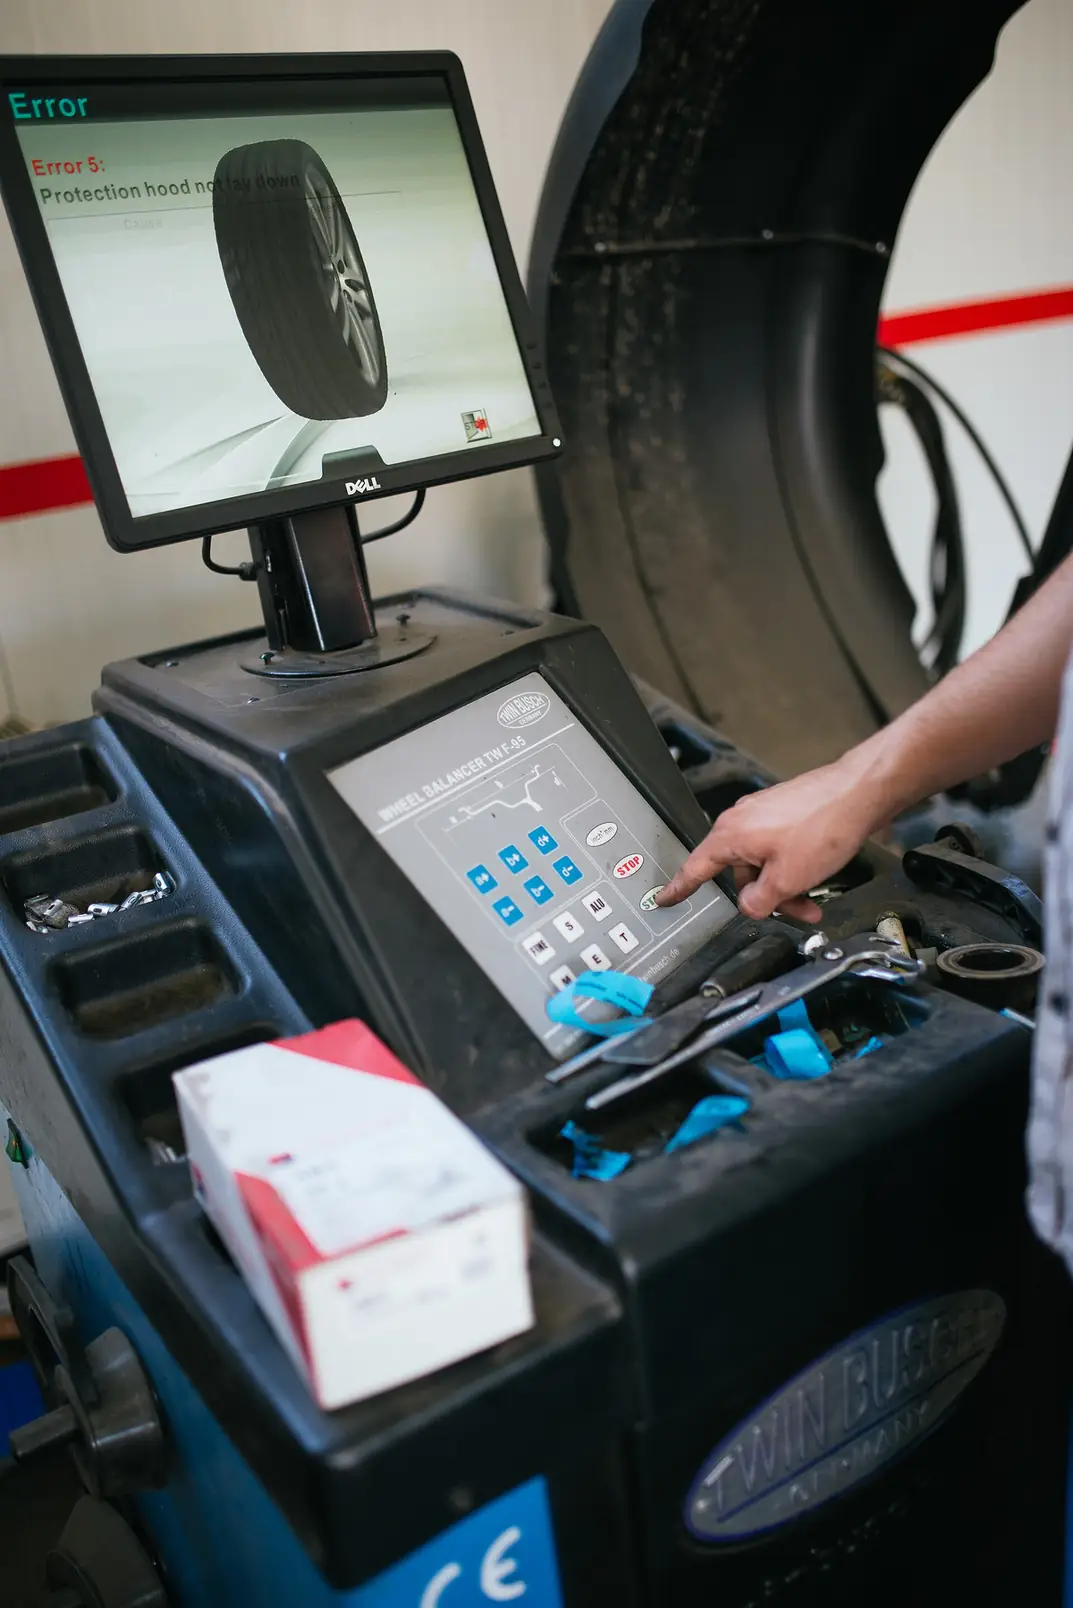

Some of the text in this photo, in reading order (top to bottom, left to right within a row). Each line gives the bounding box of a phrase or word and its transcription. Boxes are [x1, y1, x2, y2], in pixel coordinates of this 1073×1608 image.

[8, 93, 88, 119] Error
[31, 156, 106, 176] Error 5:
[40, 174, 300, 205] Protection hood not lay down
[345, 477, 381, 496] DELL
[500, 695, 546, 723] TWIN BUSCH
[377, 792, 421, 822] WHEEL
[421, 758, 487, 798] BALANCER
[483, 746, 503, 764] TW
[501, 735, 527, 754] F-95
[616, 856, 641, 877] STOP
[589, 897, 606, 914] ALU
[564, 920, 575, 932] S
[619, 931, 629, 943] T
[591, 953, 602, 965] E
